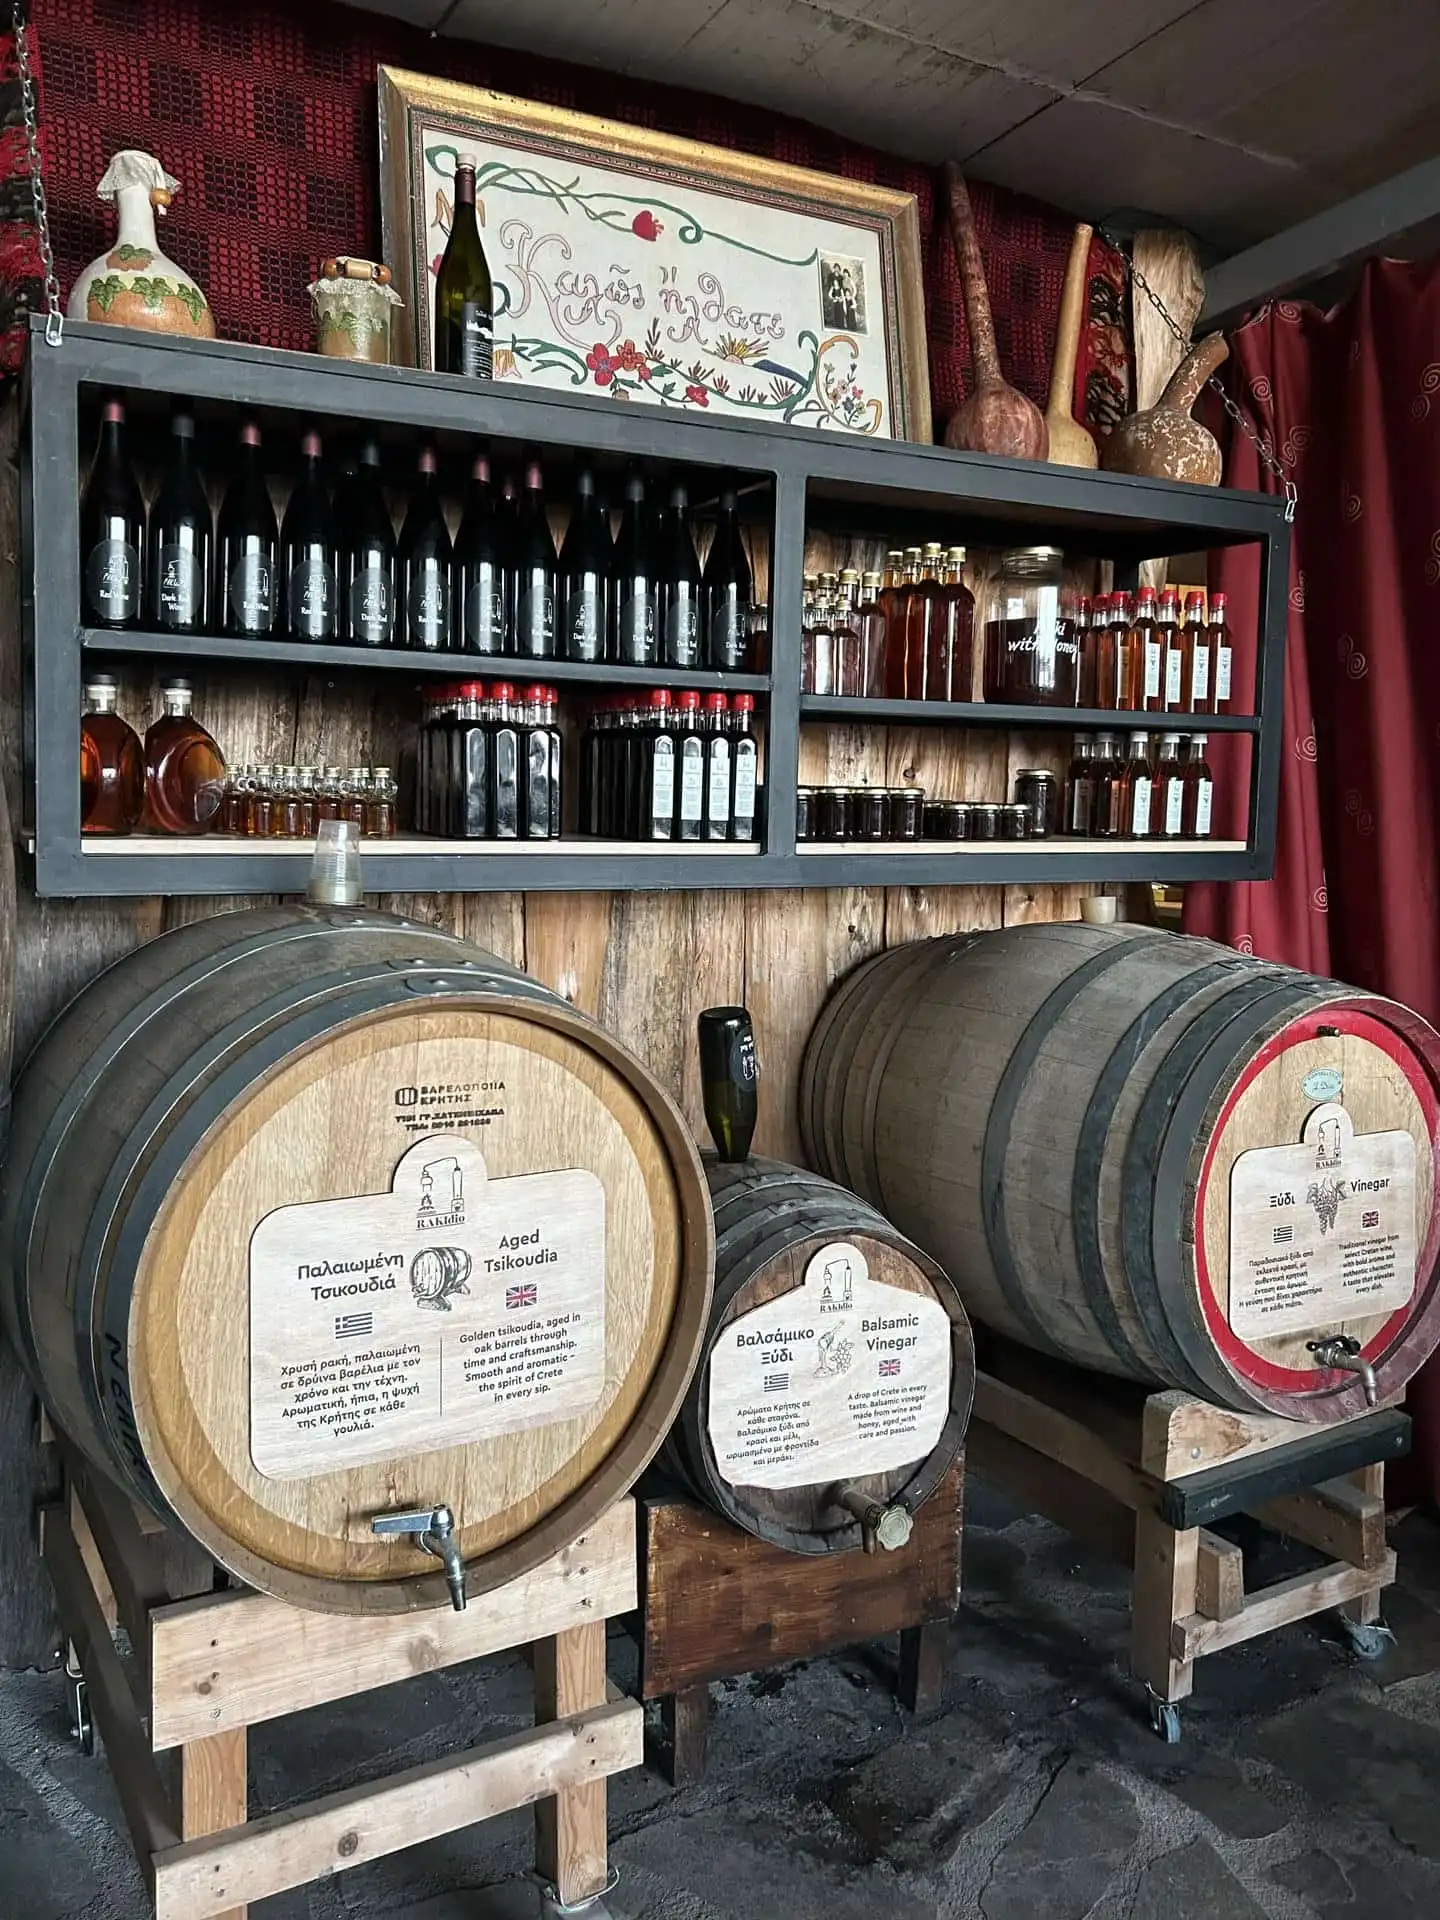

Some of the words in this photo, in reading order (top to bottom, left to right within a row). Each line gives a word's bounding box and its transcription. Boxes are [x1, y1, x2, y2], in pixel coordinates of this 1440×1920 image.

[1350, 1178, 1391, 1193] Vinegar
[1270, 1192, 1296, 1208] Ξύδι
[499, 1228, 540, 1250] Aged
[298, 1252, 404, 1281] Παλαιωμένη
[484, 1248, 558, 1273] Tsikoudia
[311, 1273, 396, 1301] Τσικουδιά
[459, 1329, 496, 1344] Golden
[498, 1319, 544, 1336] tsikoudia,
[546, 1313, 570, 1328] aged
[572, 1312, 581, 1321] in
[861, 1313, 920, 1333] Balsamic
[474, 1342, 493, 1354] oak
[495, 1336, 528, 1350] barrels
[530, 1328, 568, 1343] through
[736, 1328, 815, 1348] Βαλσάμικο
[866, 1335, 918, 1351] Vinegar
[281, 1360, 317, 1377] Χρυσή
[320, 1354, 352, 1371] ρακή,
[354, 1343, 421, 1363] παλαιωμένη
[464, 1358, 486, 1369] time
[489, 1352, 507, 1364] and
[509, 1339, 578, 1360] craftsmanship.
[761, 1348, 794, 1365] Ξύδι
[281, 1379, 294, 1390] σε
[297, 1373, 337, 1388] δρύινα
[339, 1364, 384, 1381] βαρέλια
[387, 1361, 400, 1372] με
[403, 1357, 421, 1367] τον
[465, 1366, 504, 1382] Smooth
[506, 1361, 524, 1374] and
[526, 1353, 568, 1370] aromatic
[294, 1388, 329, 1404] χρόνο
[332, 1384, 350, 1395] και
[352, 1380, 371, 1391] την
[374, 1374, 408, 1387] τέχνη.
[478, 1382, 495, 1393] the
[498, 1375, 522, 1390] spirit
[525, 1371, 535, 1383] of
[537, 1368, 564, 1380] Crete
[282, 1397, 347, 1418] Αρωματική,
[350, 1393, 378, 1406] ήπια,
[382, 1391, 389, 1400] η
[392, 1382, 420, 1398] ψυχή
[494, 1392, 503, 1403] in
[506, 1387, 533, 1400] every
[535, 1384, 551, 1394] sip.
[297, 1418, 317, 1430] της
[320, 1409, 361, 1425] Κρήτης
[363, 1406, 377, 1416] σε
[380, 1400, 406, 1412] κάθε
[333, 1420, 375, 1437] γουλιά.
